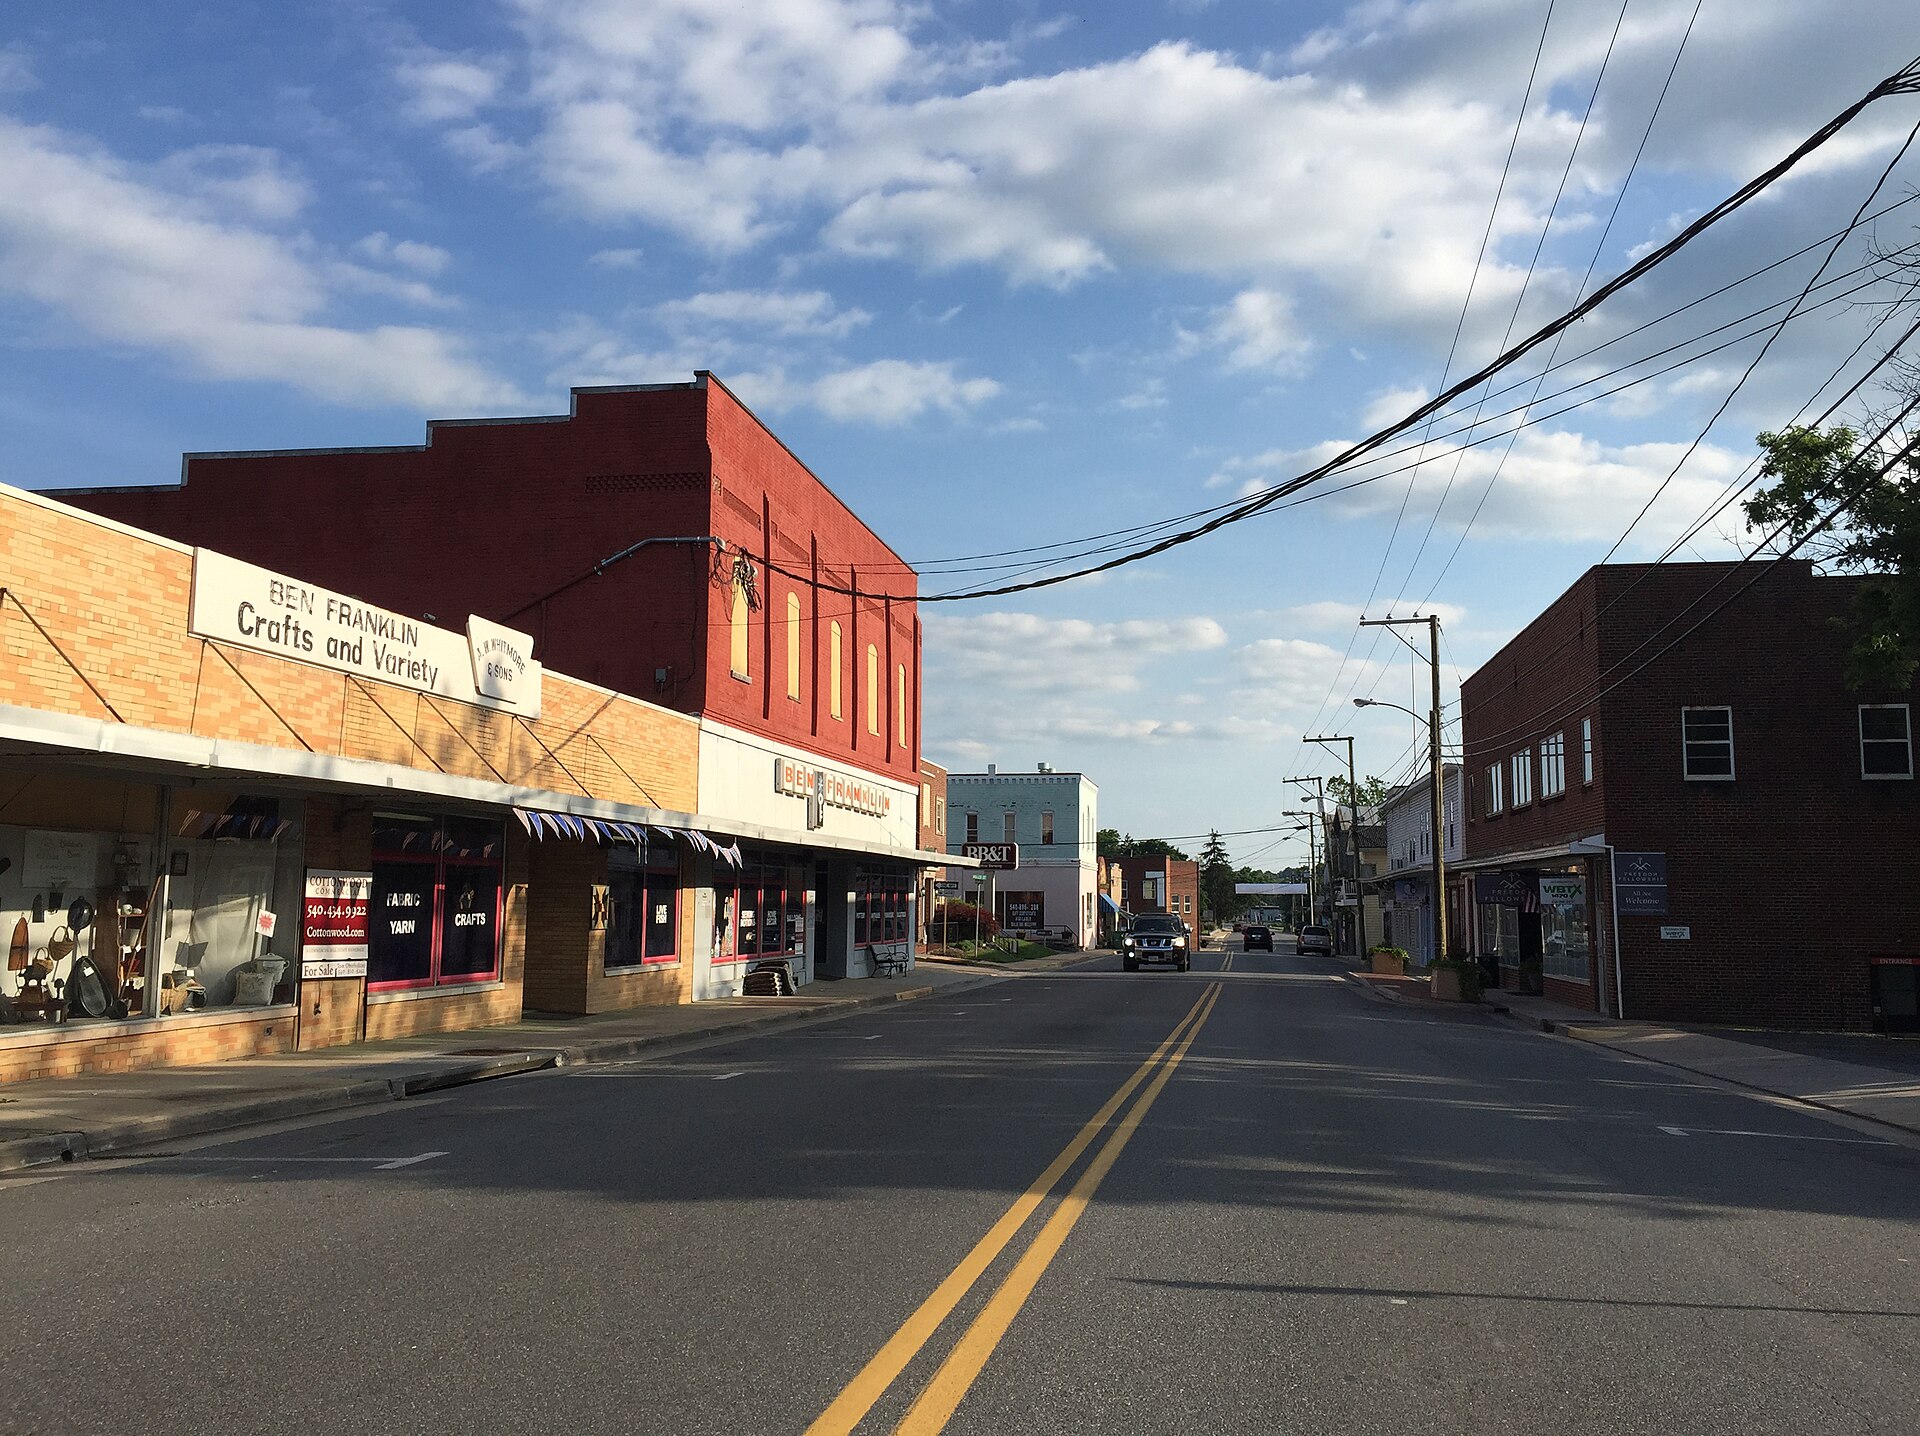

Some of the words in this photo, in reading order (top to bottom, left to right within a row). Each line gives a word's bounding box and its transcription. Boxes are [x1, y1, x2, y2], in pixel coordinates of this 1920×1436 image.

[269, 579, 315, 615] BEN
[326, 597, 418, 647] FRANKLIN
[237, 600, 313, 653] Crafts
[326, 636, 363, 666] and
[373, 639, 439, 690] Variety
[491, 638, 526, 675] WHITMORE
[487, 662, 493, 677] &
[494, 664, 513, 682] SONS
[785, 766, 814, 789] BEN
[827, 779, 890, 810] FRANKLIN
[966, 845, 1011, 861] BB&T
[309, 875, 368, 888] COTTONWOOD
[1543, 884, 1583, 899] WBTX
[386, 892, 421, 907] FABRIC
[1625, 897, 1660, 905] Welcome
[306, 904, 367, 919] 540.434.9922
[455, 912, 486, 926] CRAFTS
[306, 925, 365, 938] Cottonwood.com
[389, 920, 415, 934] YARN
[304, 965, 317, 976] For
[318, 963, 334, 976] Sale
